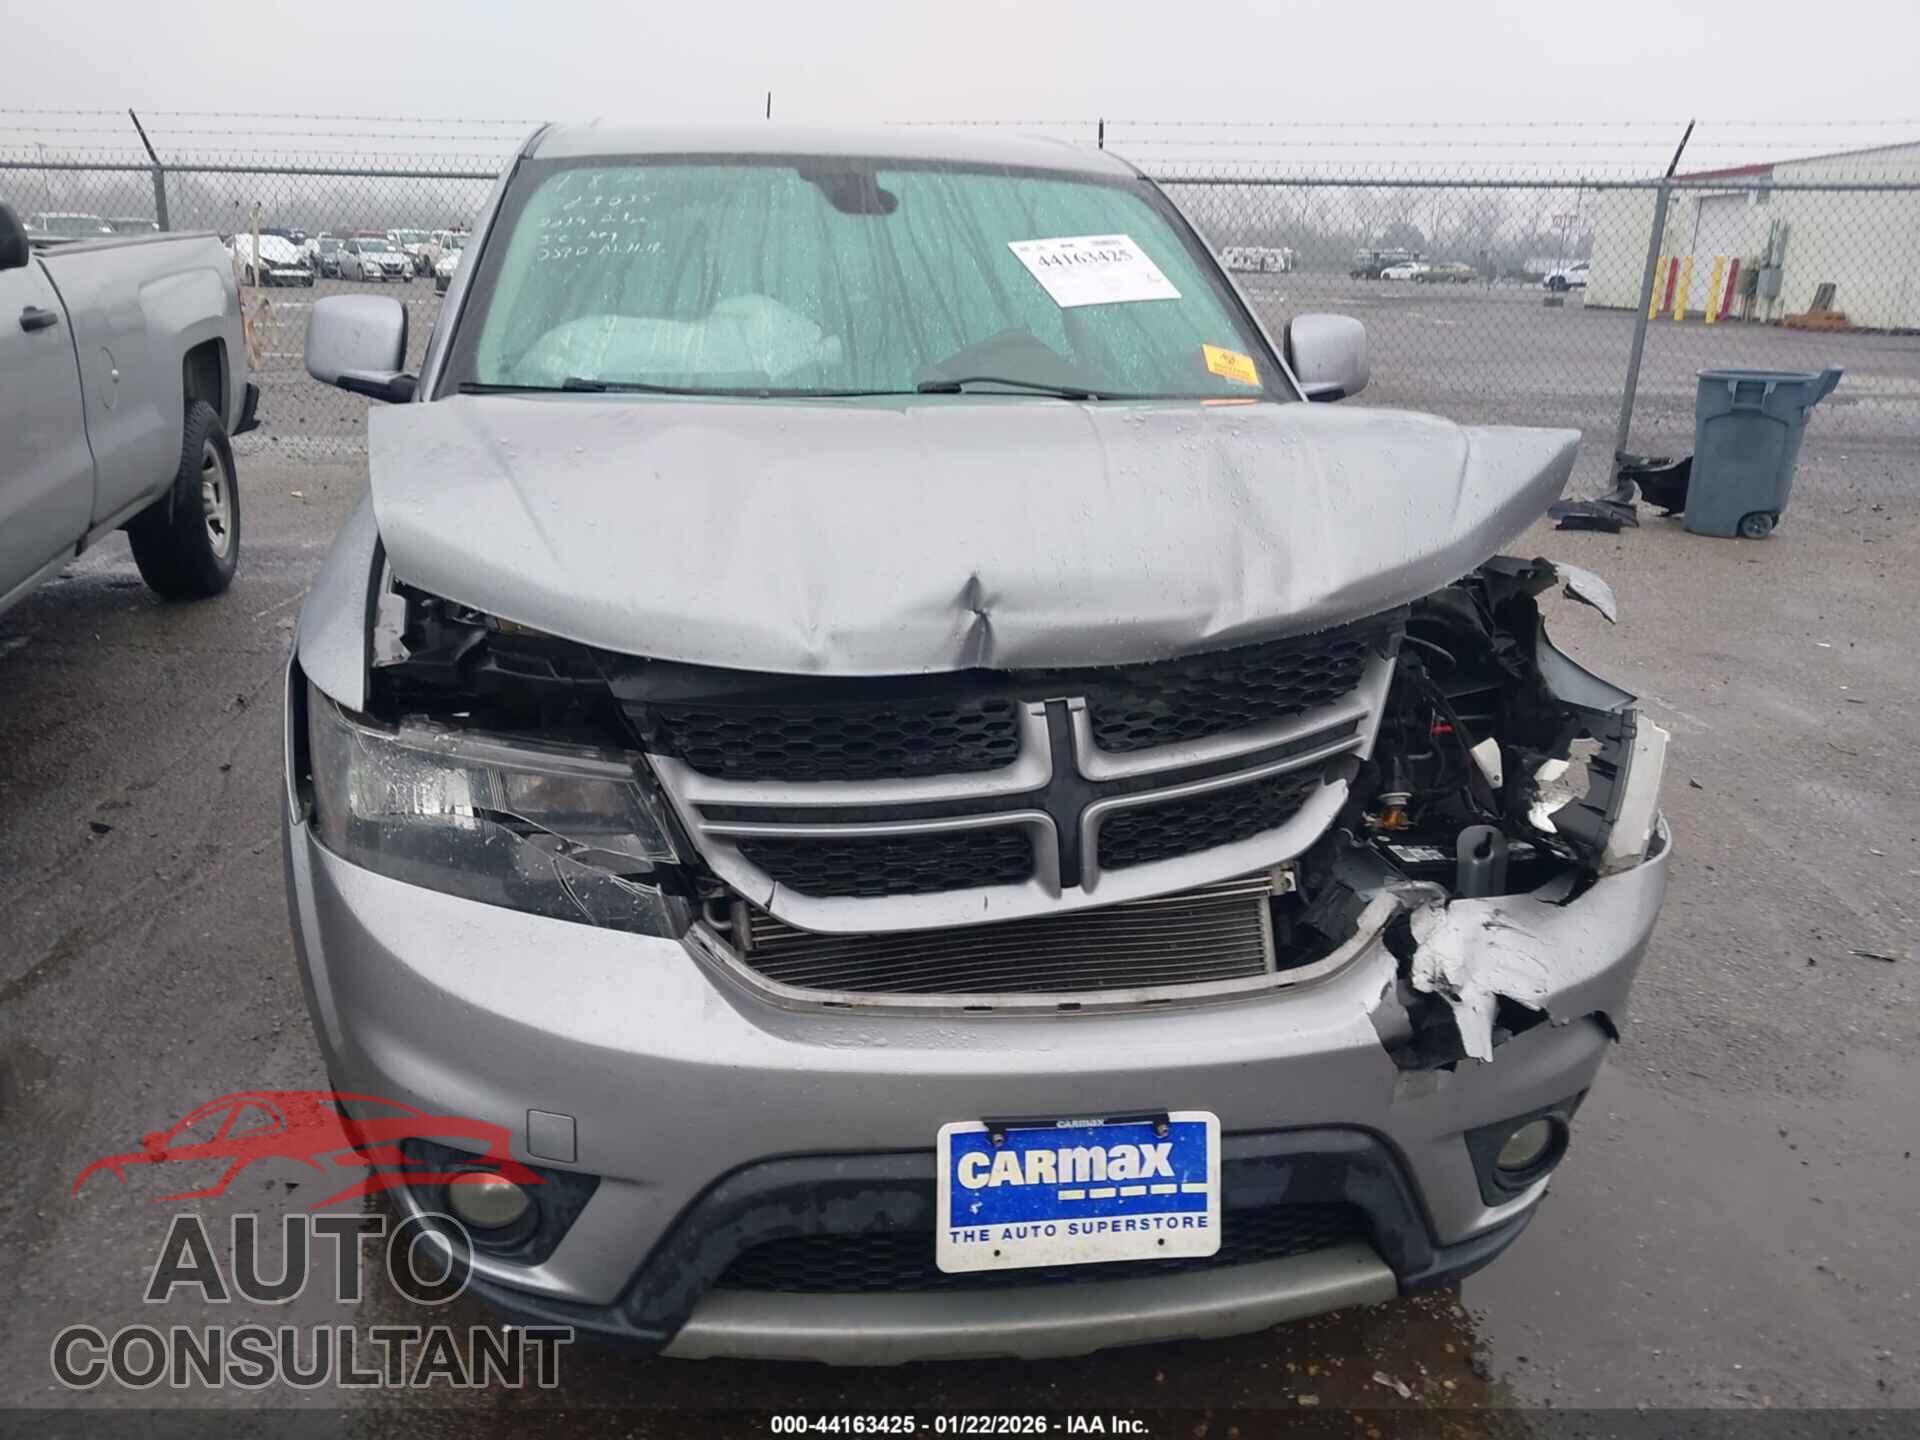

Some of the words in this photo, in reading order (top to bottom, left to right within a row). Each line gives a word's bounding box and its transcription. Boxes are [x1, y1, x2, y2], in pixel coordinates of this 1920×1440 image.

[957, 1142, 1175, 1190] CARmax
[950, 1229, 991, 1244] THE
[1002, 1223, 1057, 1241] AUTO
[1068, 1215, 1209, 1236] SUPERSTORE
